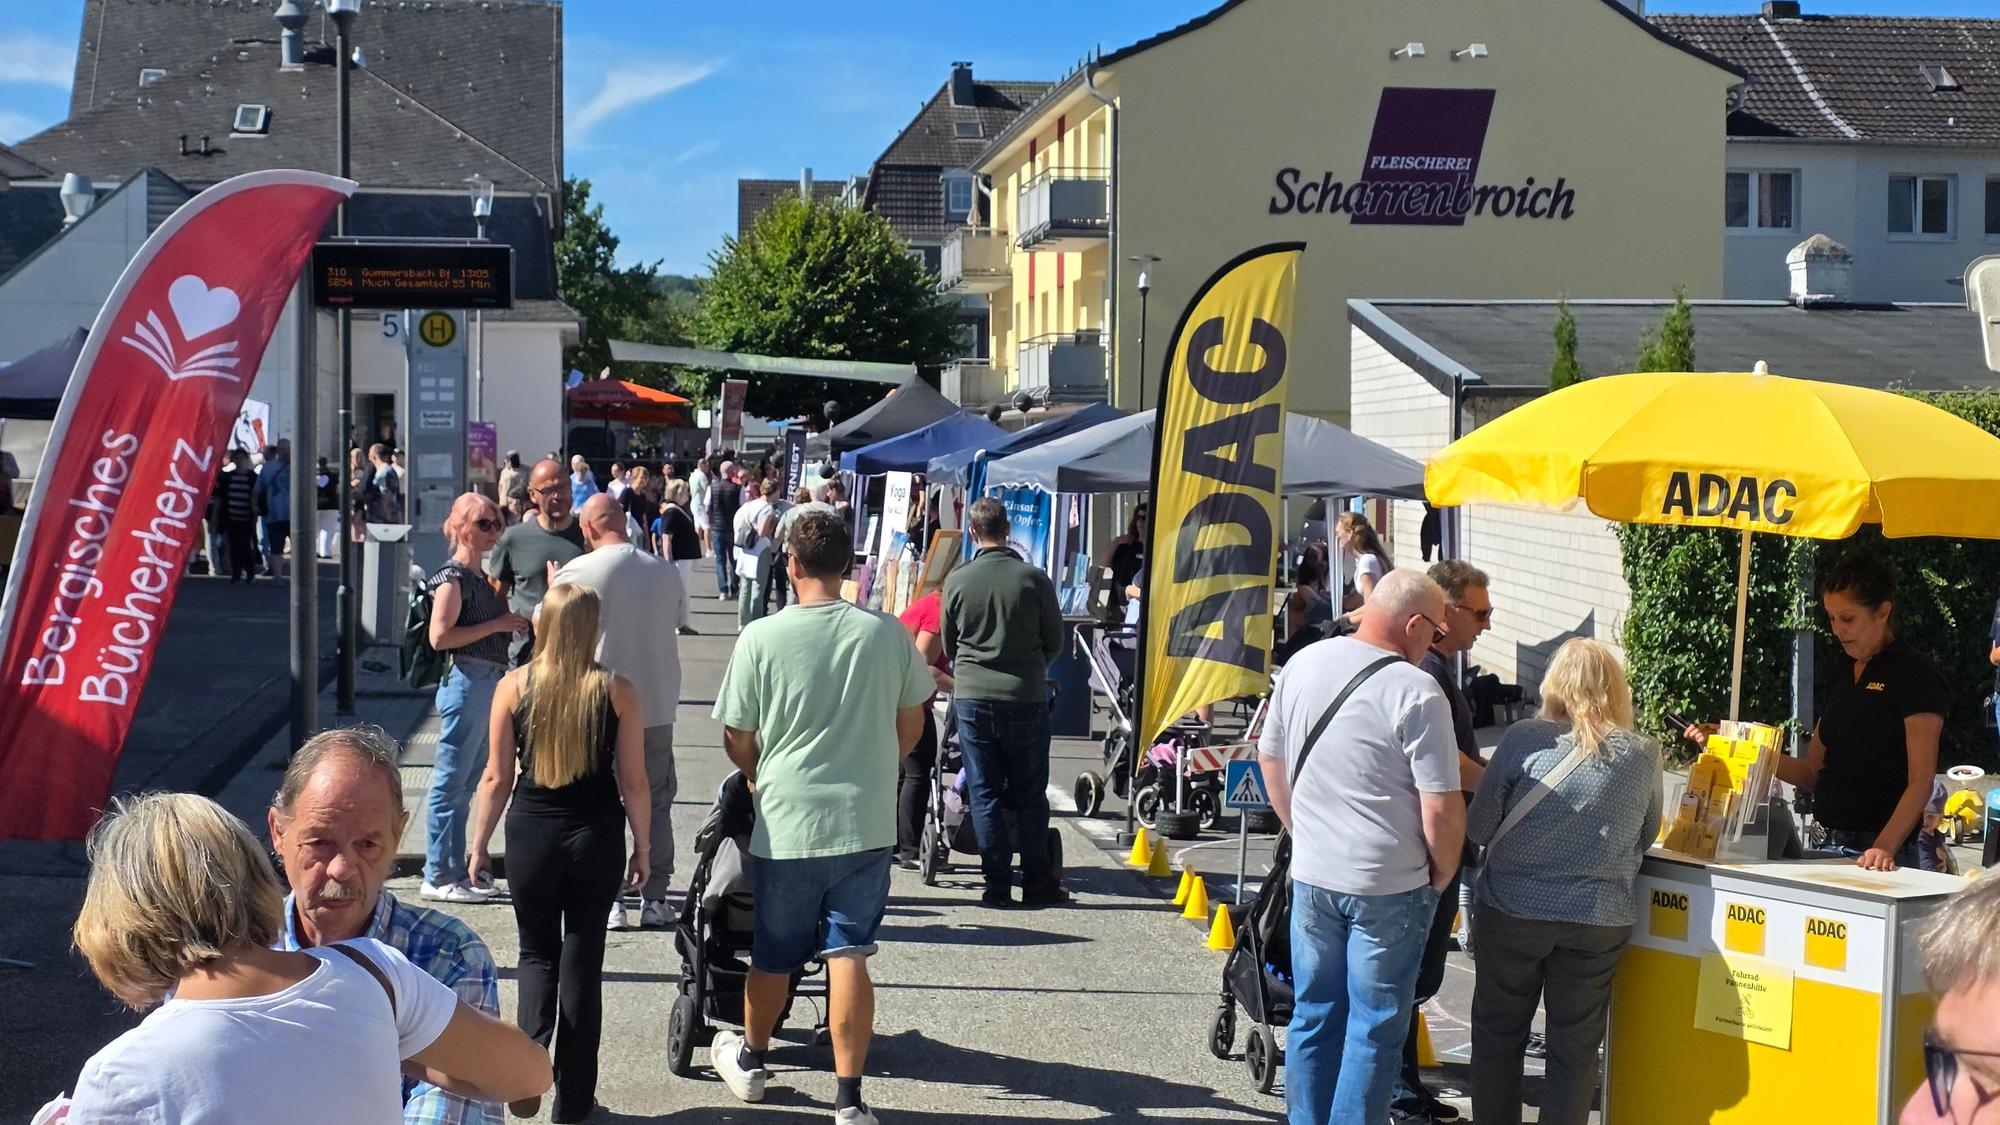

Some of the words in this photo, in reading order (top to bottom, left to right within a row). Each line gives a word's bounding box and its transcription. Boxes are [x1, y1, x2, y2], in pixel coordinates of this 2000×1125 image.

[1370, 155, 1473, 170] FLEISCHEREI
[1269, 167, 1577, 220] Scharrenbroich
[327, 267, 347, 277] 310
[361, 268, 435, 278] Gummersbach
[461, 269, 490, 279] 13:05
[361, 278, 391, 288] Much
[470, 280, 491, 289] Min
[383, 314, 398, 338] 5
[890, 484, 907, 502] Yoga
[1166, 316, 1287, 674] ADAC
[1661, 471, 1797, 525] ADAC
[1004, 499, 1040, 513] Einsatz
[21, 429, 138, 686] Bergisches
[78, 438, 214, 706] Bücherherz
[1865, 682, 1885, 691] ADAC
[1651, 890, 1689, 911] ADAC
[1727, 903, 1766, 926] ADAC
[1806, 917, 1848, 941] ADAC
[1725, 977, 1768, 993] Pannenhilfe
